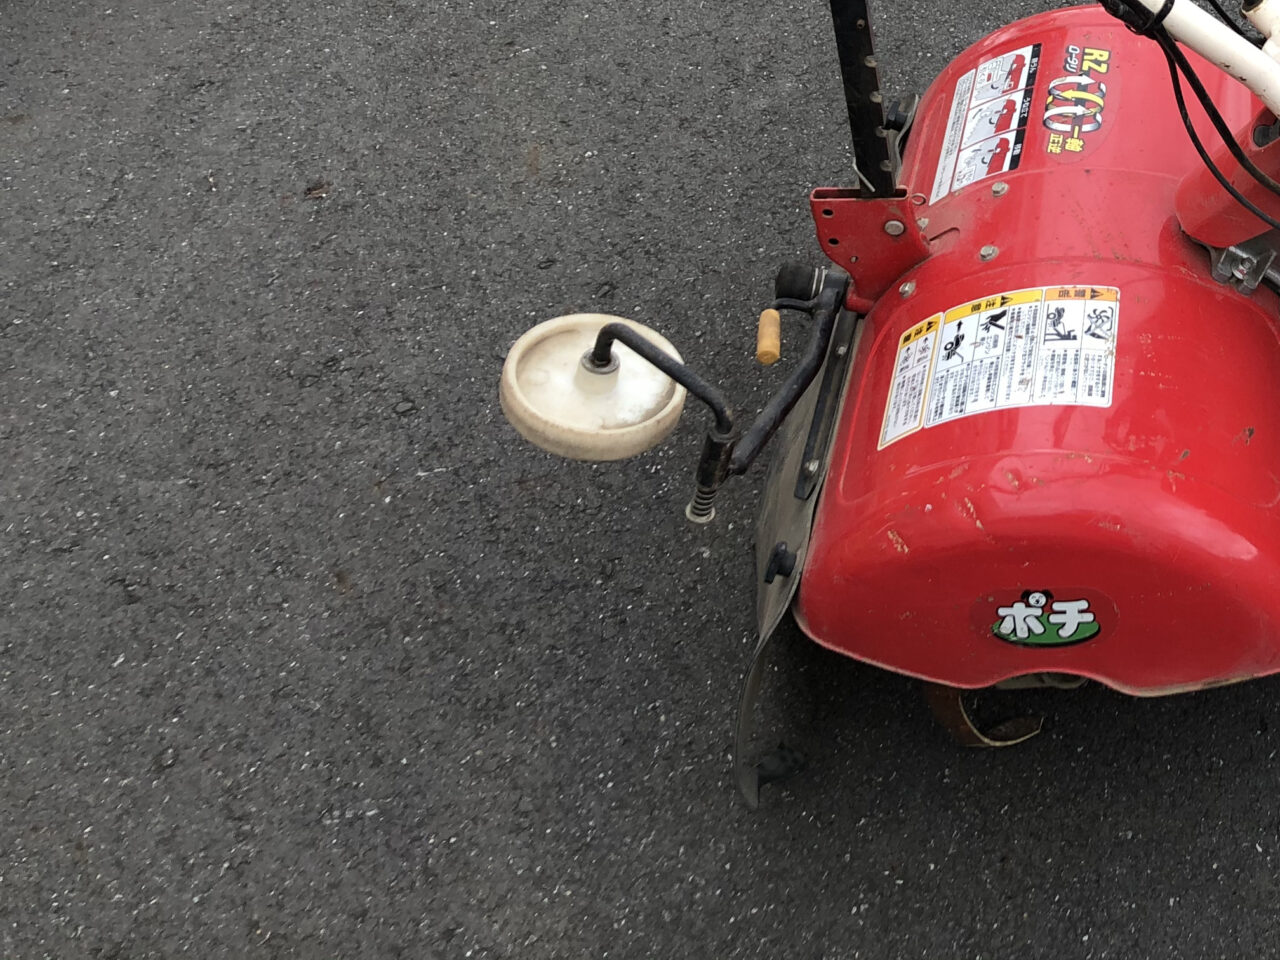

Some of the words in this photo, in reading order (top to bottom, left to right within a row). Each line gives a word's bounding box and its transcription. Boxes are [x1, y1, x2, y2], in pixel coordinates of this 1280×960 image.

[1083, 48, 1109, 73] RZ
[1048, 133, 1064, 154] 正逆
[1064, 126, 1085, 152] 一軸
[997, 591, 1095, 638] ポチ
